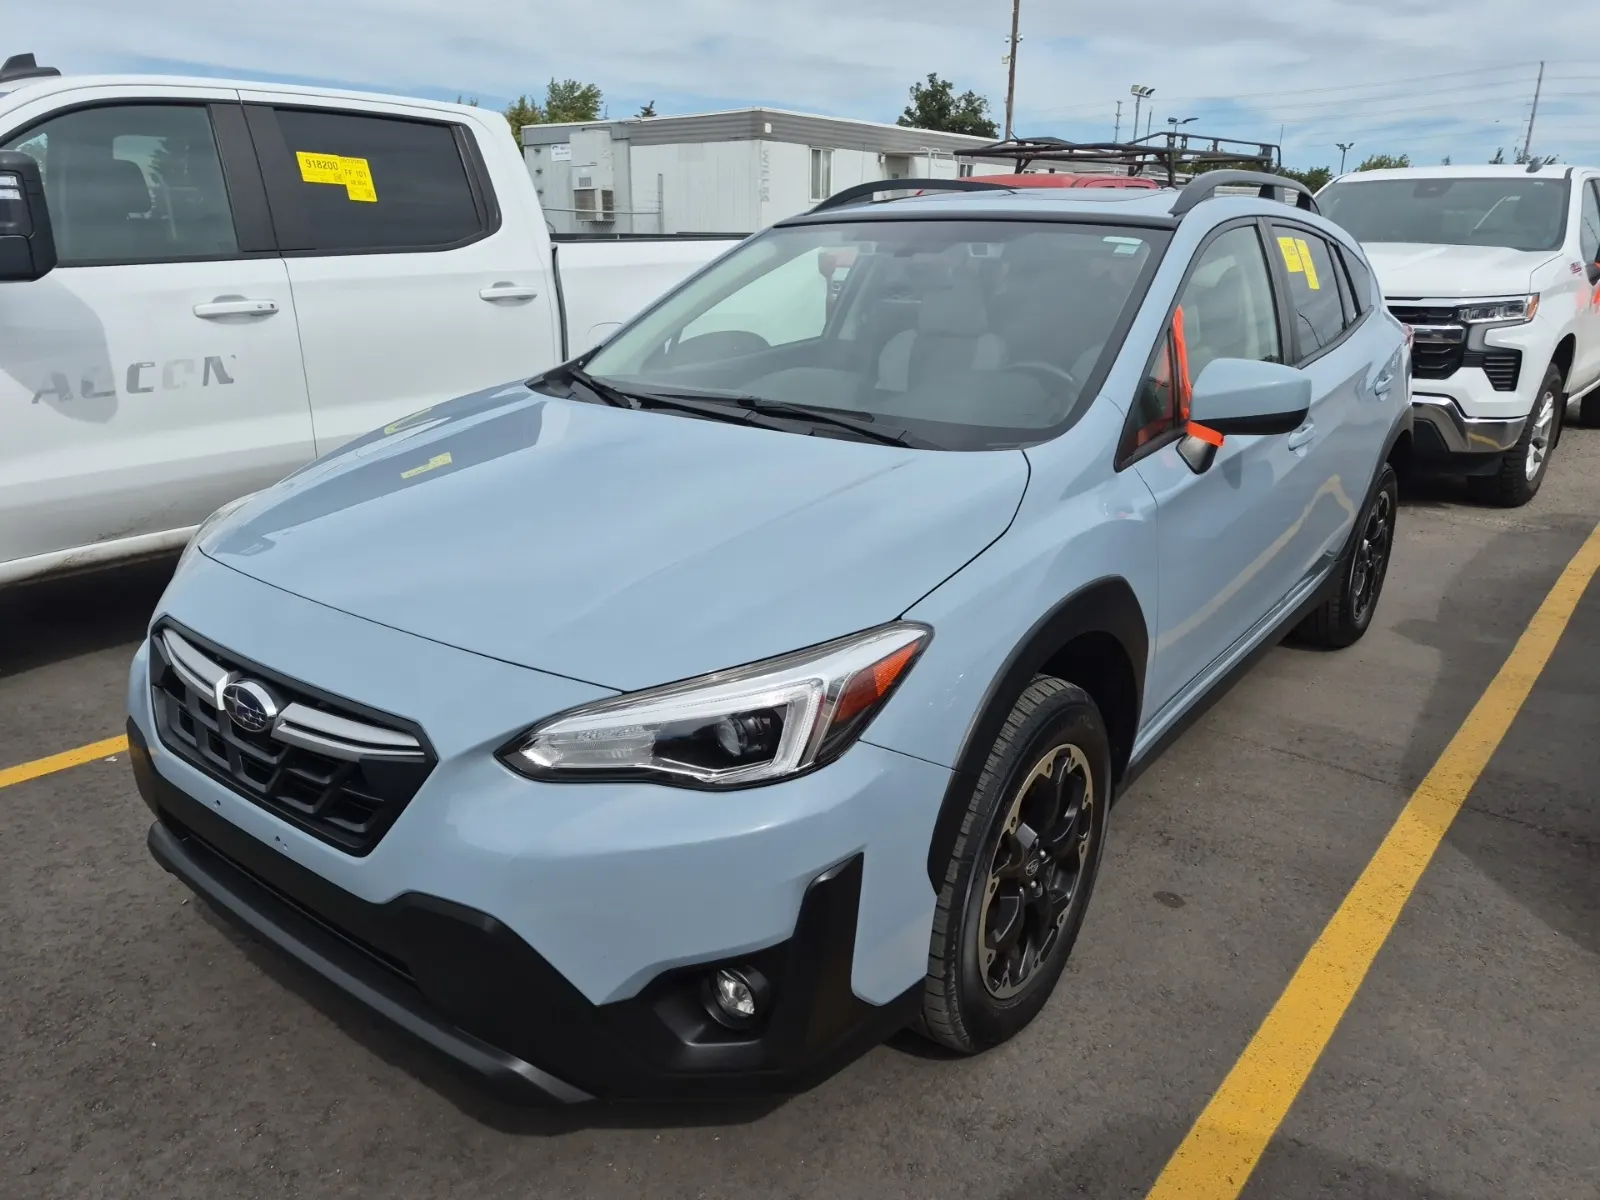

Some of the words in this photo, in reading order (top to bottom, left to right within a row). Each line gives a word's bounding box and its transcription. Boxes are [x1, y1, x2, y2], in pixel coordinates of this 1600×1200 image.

[305, 159, 339, 171] 918200
[344, 168, 352, 177] FF
[355, 170, 367, 178] 101
